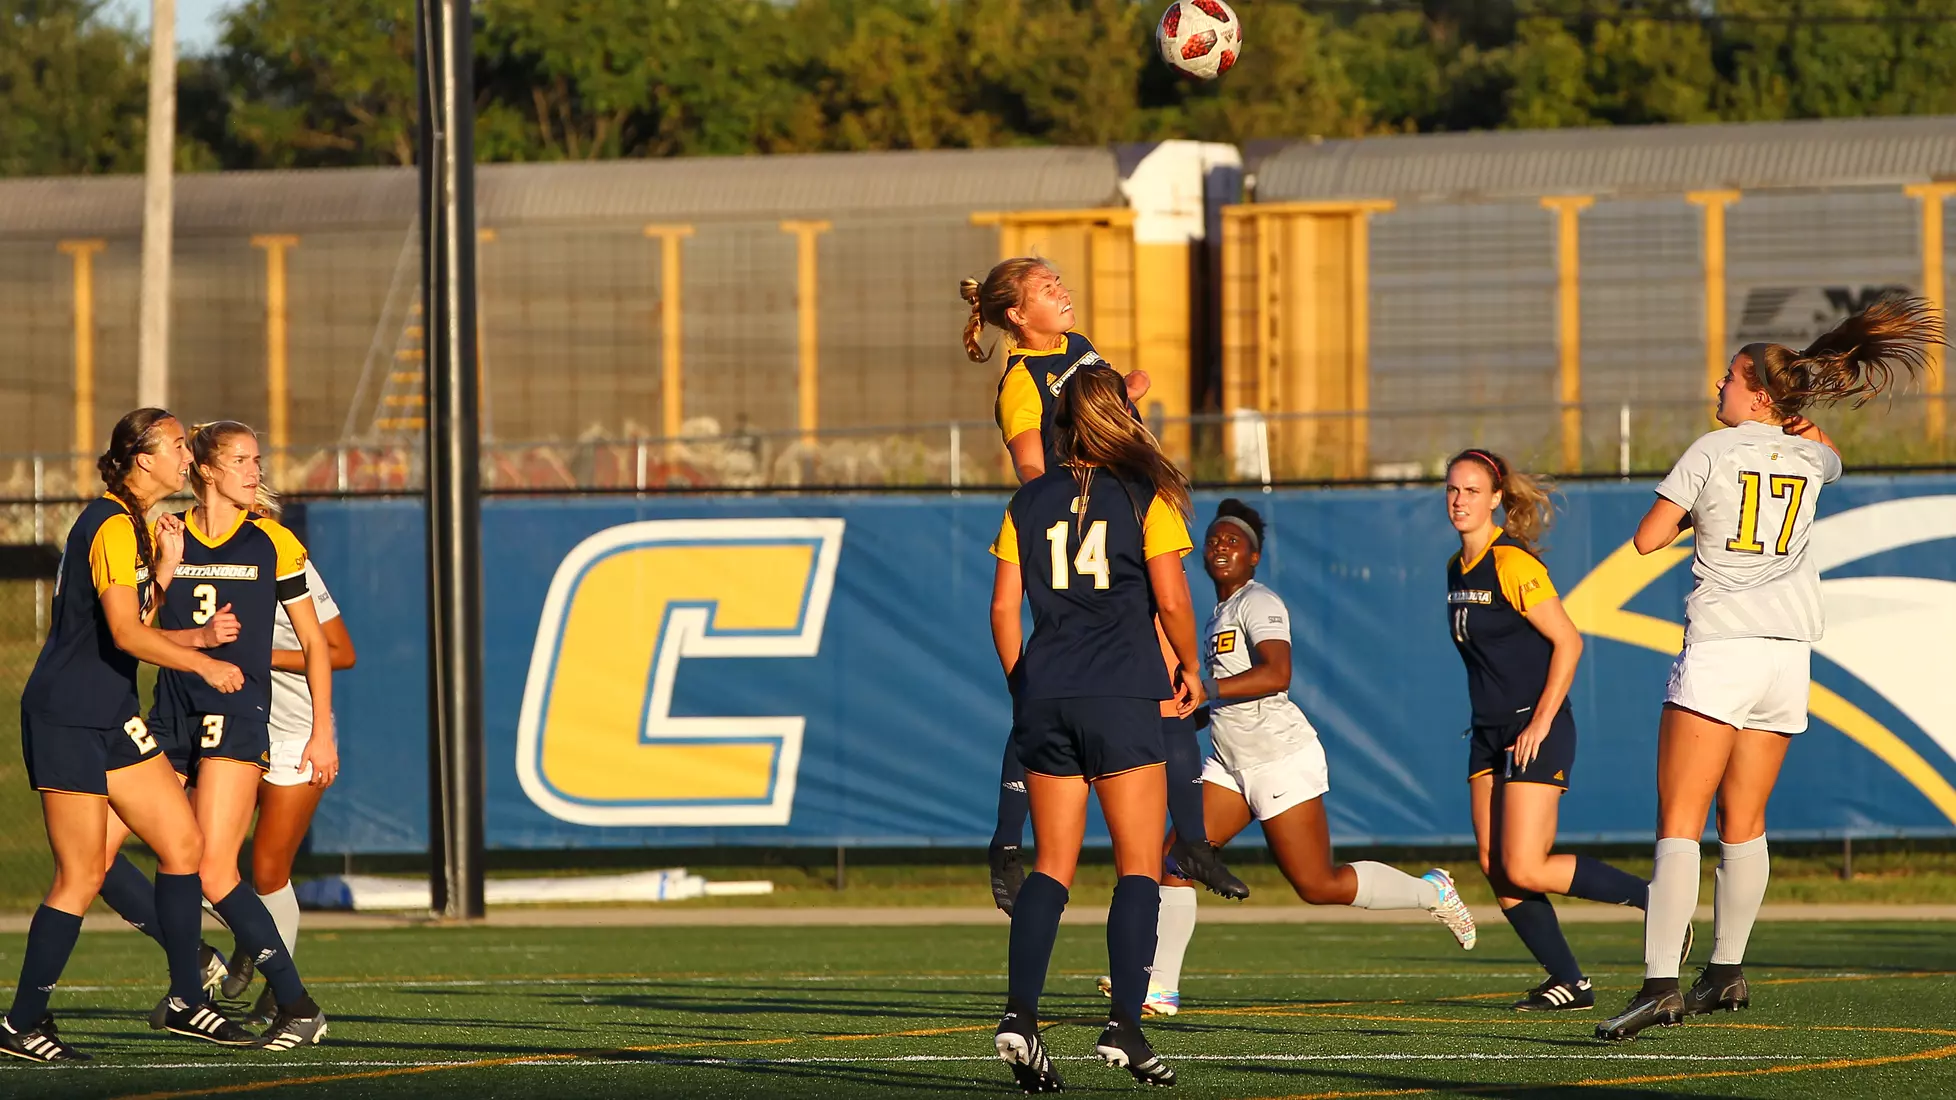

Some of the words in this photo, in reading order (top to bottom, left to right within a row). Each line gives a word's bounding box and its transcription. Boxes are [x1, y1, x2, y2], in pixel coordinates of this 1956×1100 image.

[1726, 470, 1807, 556] 17
[174, 564, 257, 580] HATTANOOGA
[1046, 520, 1110, 590] 14
[192, 584, 217, 625] 3
[515, 518, 846, 827] C
[123, 715, 158, 756] 2
[200, 714, 225, 749] 3
